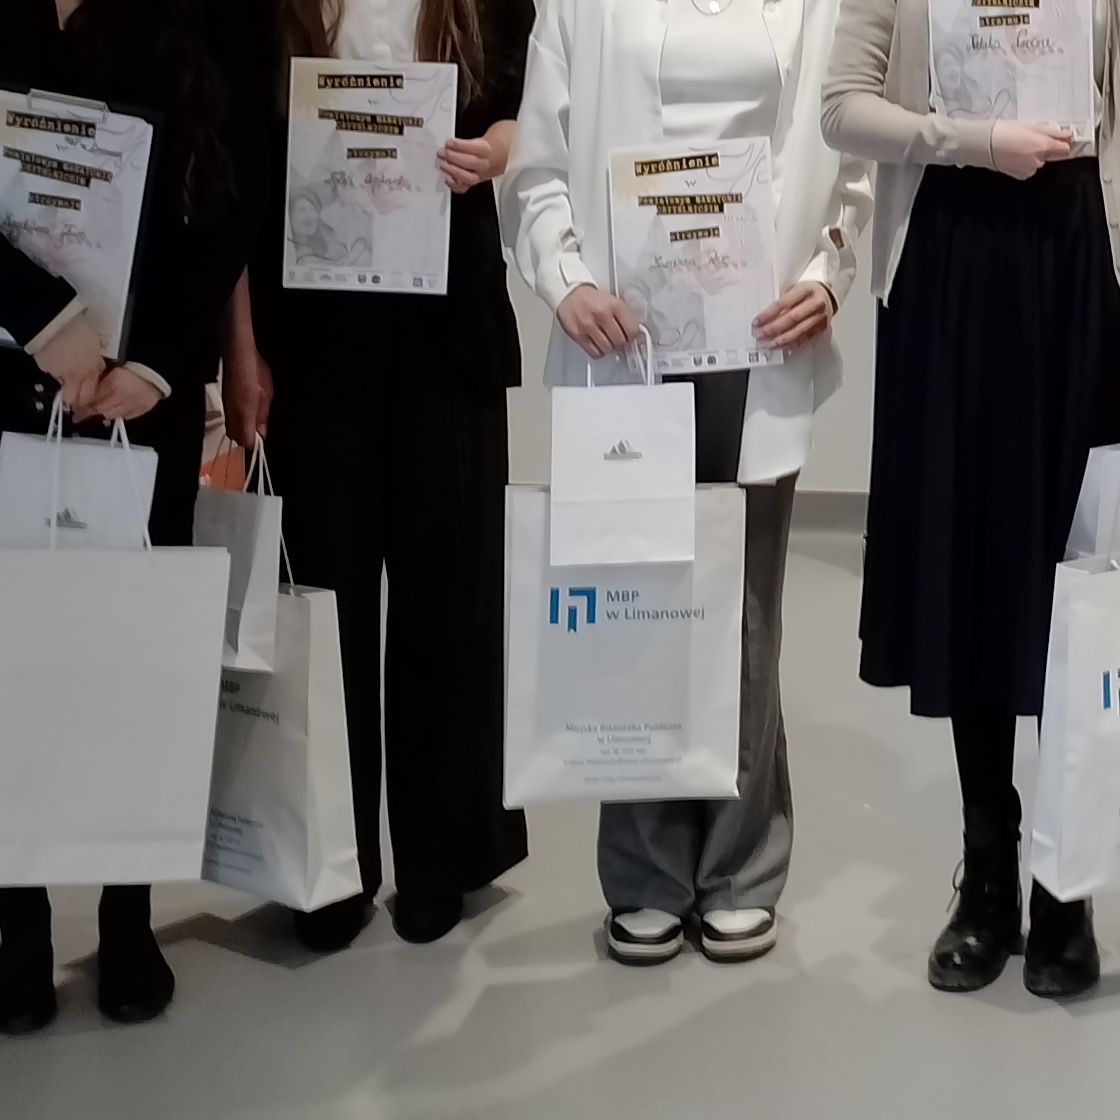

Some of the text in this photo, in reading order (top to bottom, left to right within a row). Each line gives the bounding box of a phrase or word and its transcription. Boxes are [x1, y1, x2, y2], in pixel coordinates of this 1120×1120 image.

[606, 590, 639, 602] MBP
[606, 607, 705, 621] w Limanowej
